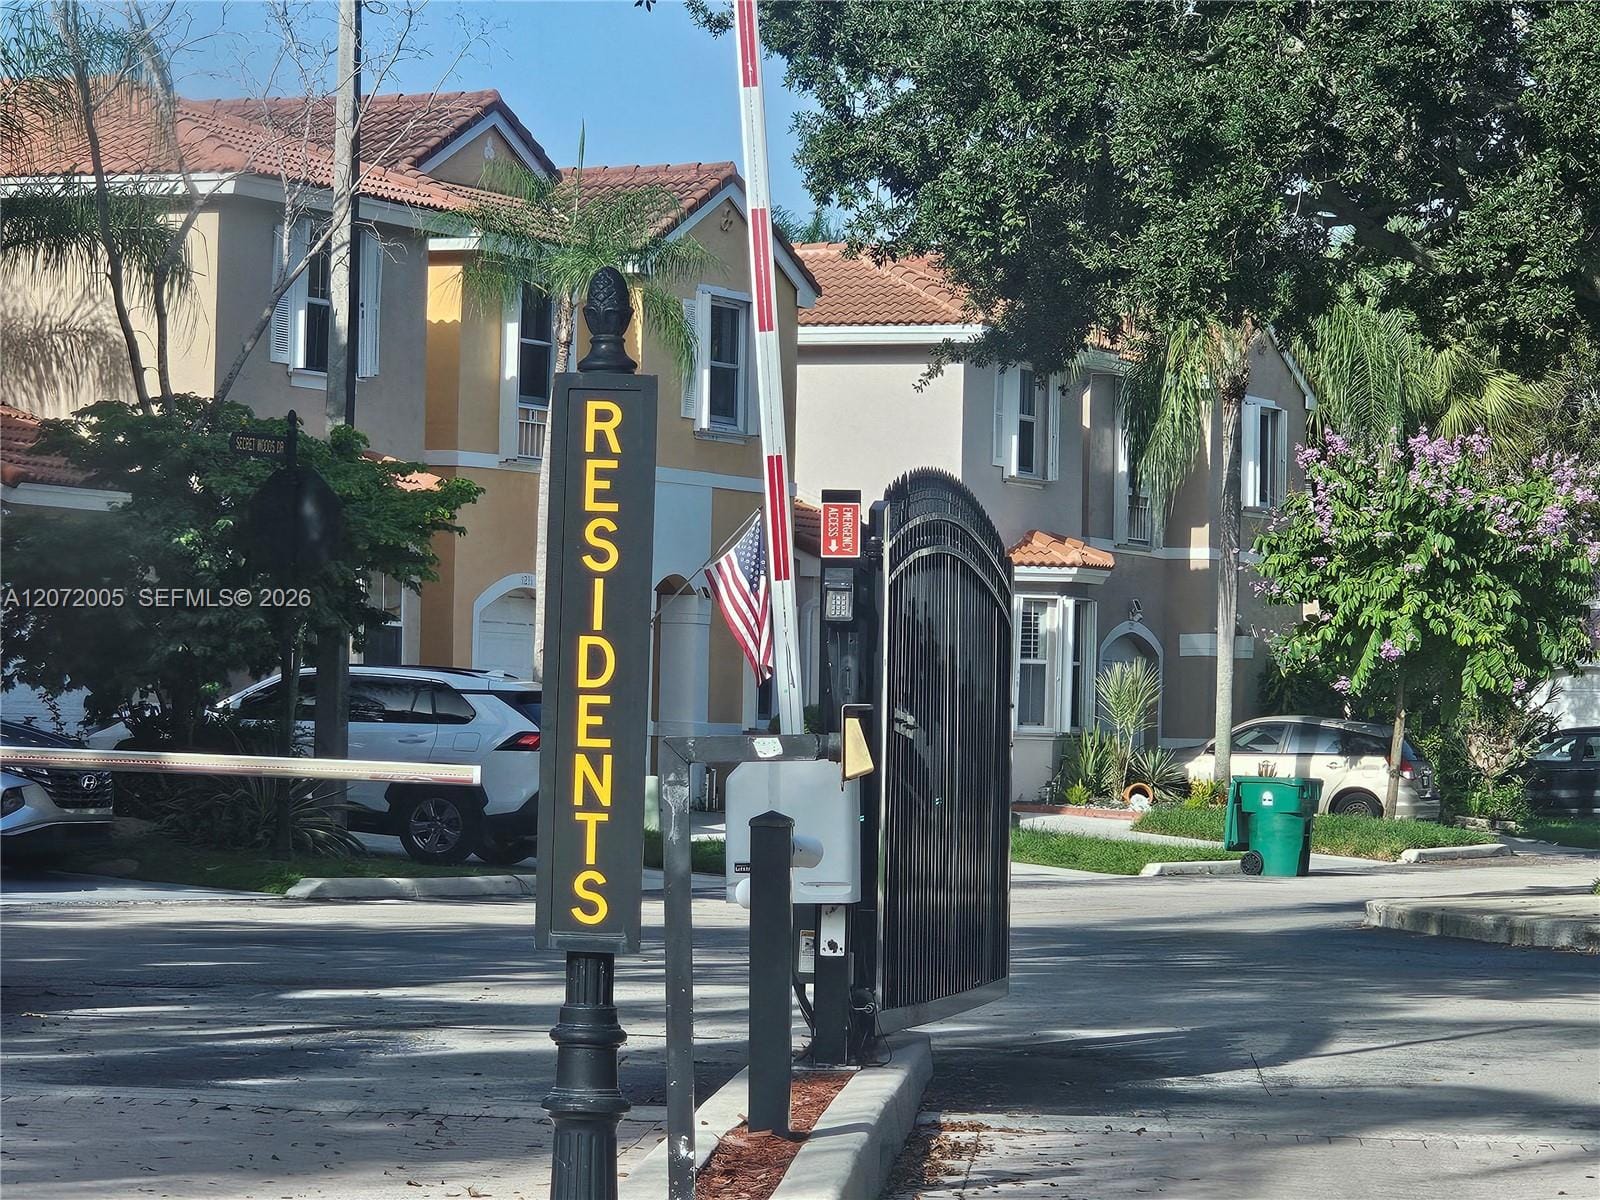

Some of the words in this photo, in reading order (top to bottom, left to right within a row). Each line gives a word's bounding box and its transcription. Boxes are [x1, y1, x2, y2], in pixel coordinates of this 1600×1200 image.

[828, 507, 838, 537] ACCESS
[842, 507, 853, 552] EMERGENCY
[571, 399, 623, 927] RESIDENTS
